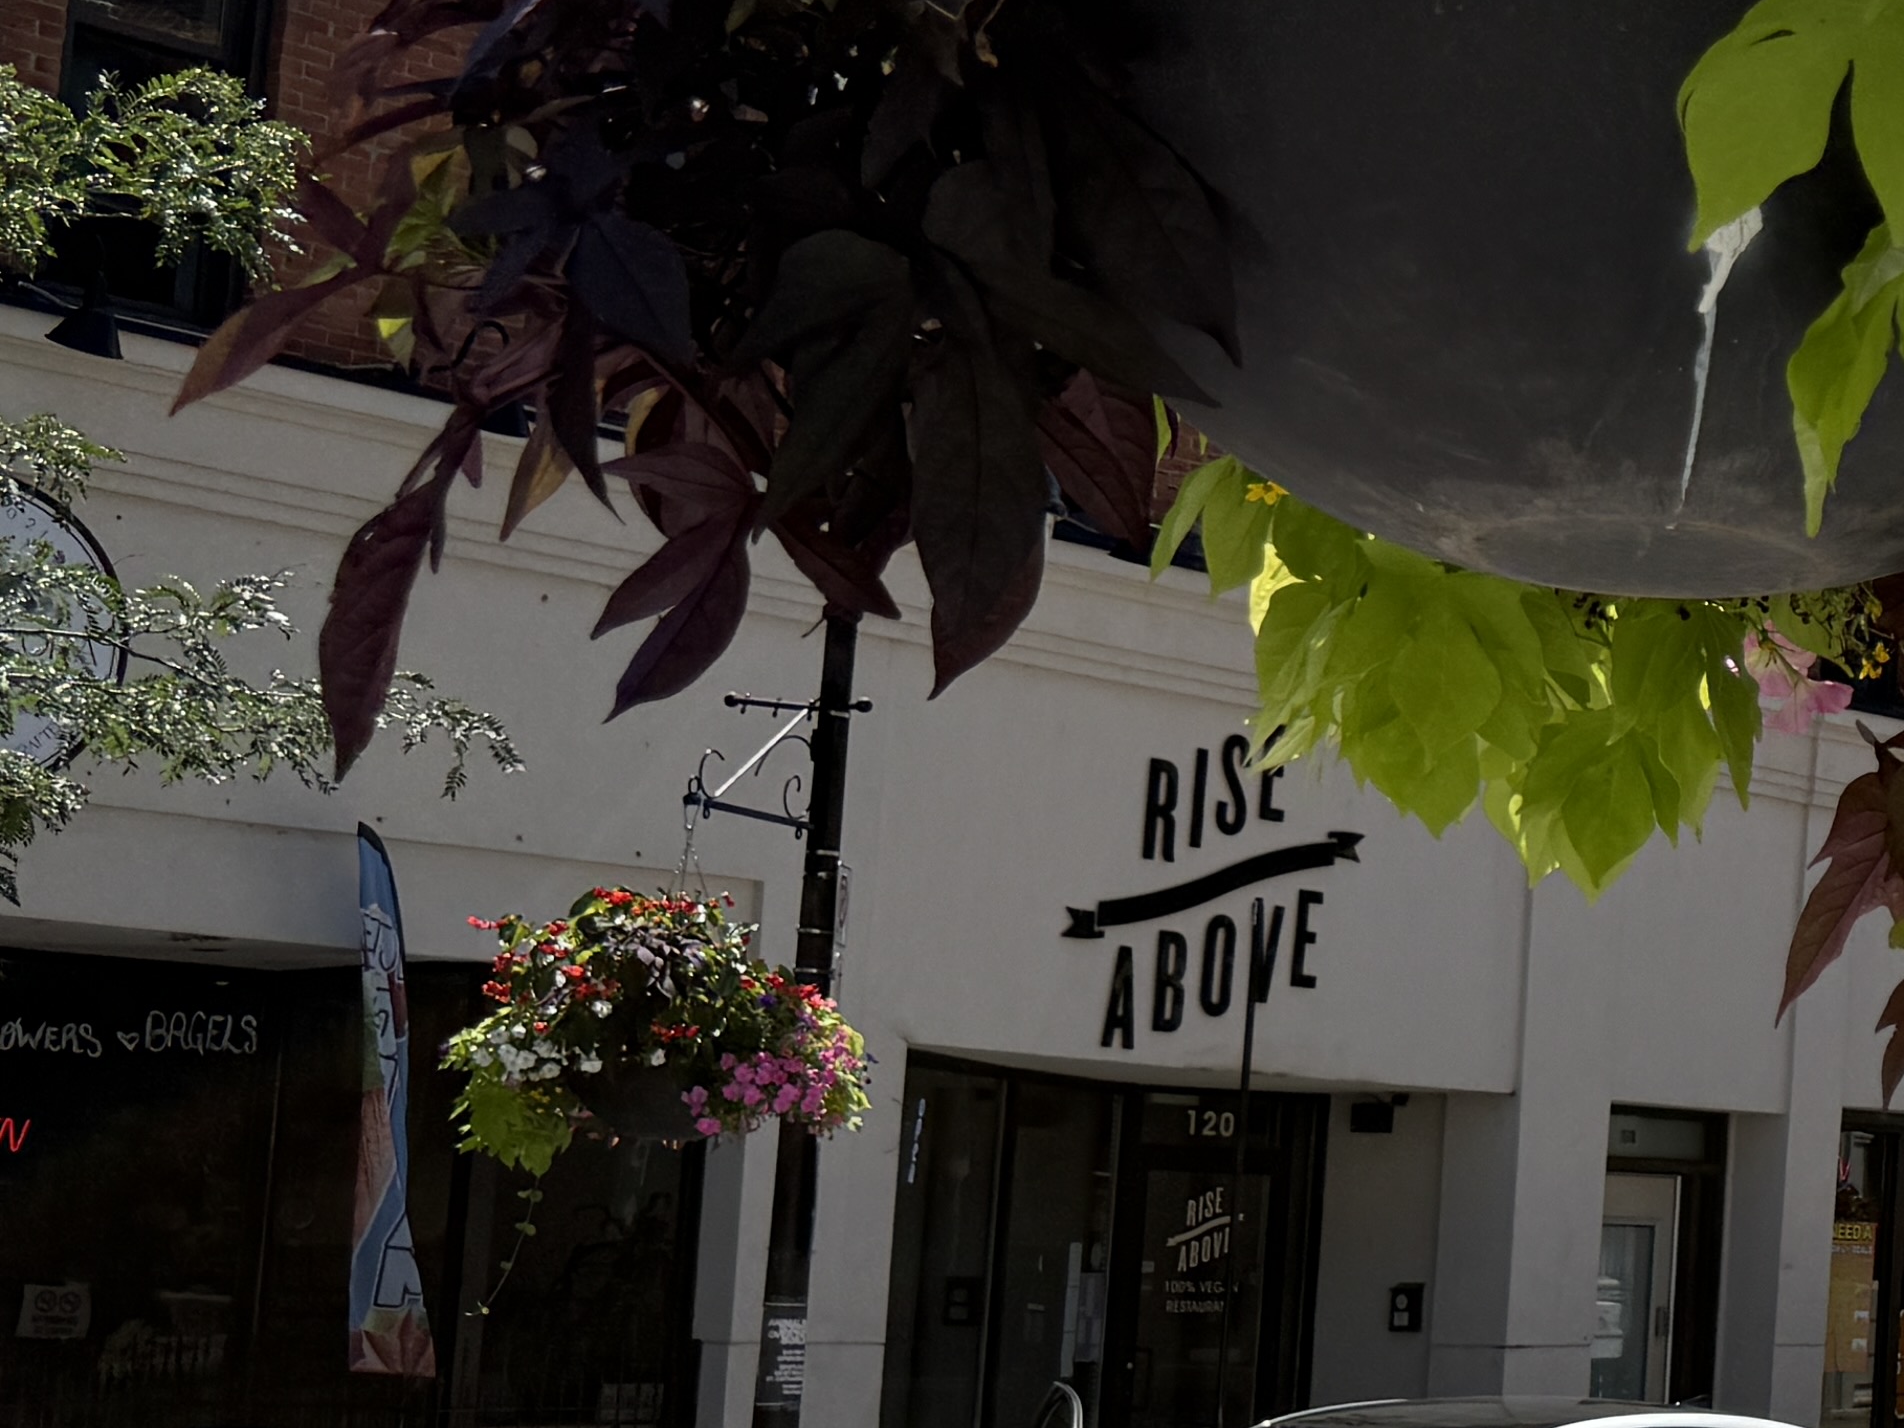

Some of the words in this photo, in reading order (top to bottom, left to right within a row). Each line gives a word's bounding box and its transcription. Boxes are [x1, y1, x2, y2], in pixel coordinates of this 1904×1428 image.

[1142, 725, 1286, 863] RISE
[1100, 889, 1324, 1050] ABOVE
[145, 1010, 257, 1056] BAGELS
[1187, 1109, 1235, 1137] 120
[1186, 1186, 1224, 1227] RISE
